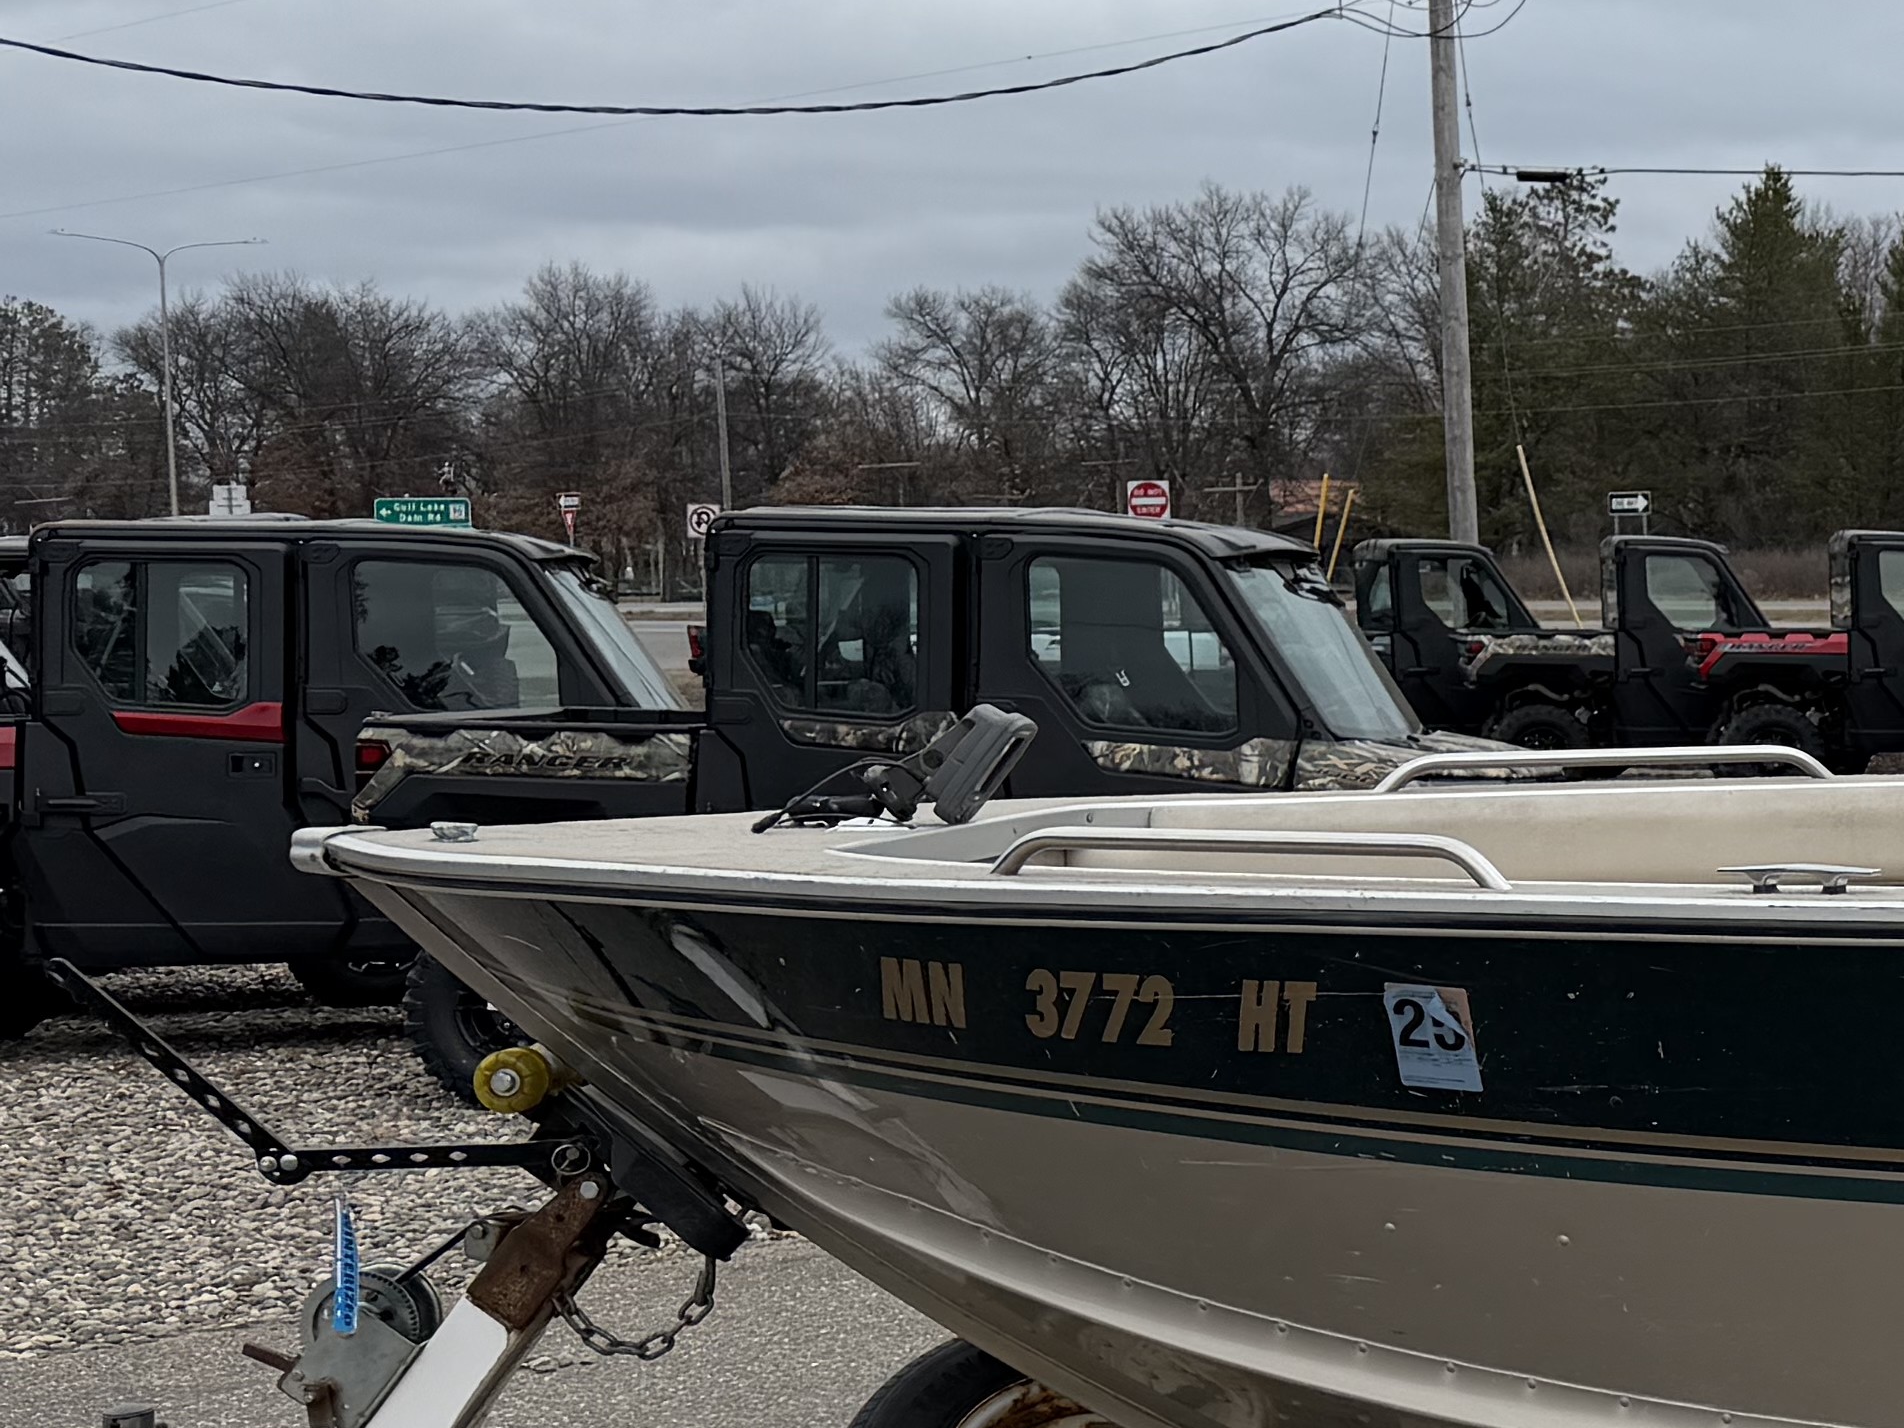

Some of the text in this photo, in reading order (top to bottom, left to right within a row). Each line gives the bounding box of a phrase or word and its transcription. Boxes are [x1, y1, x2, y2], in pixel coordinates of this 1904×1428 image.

[458, 751, 632, 769] RANGER
[880, 956, 1318, 1054] MN 3772 HT
